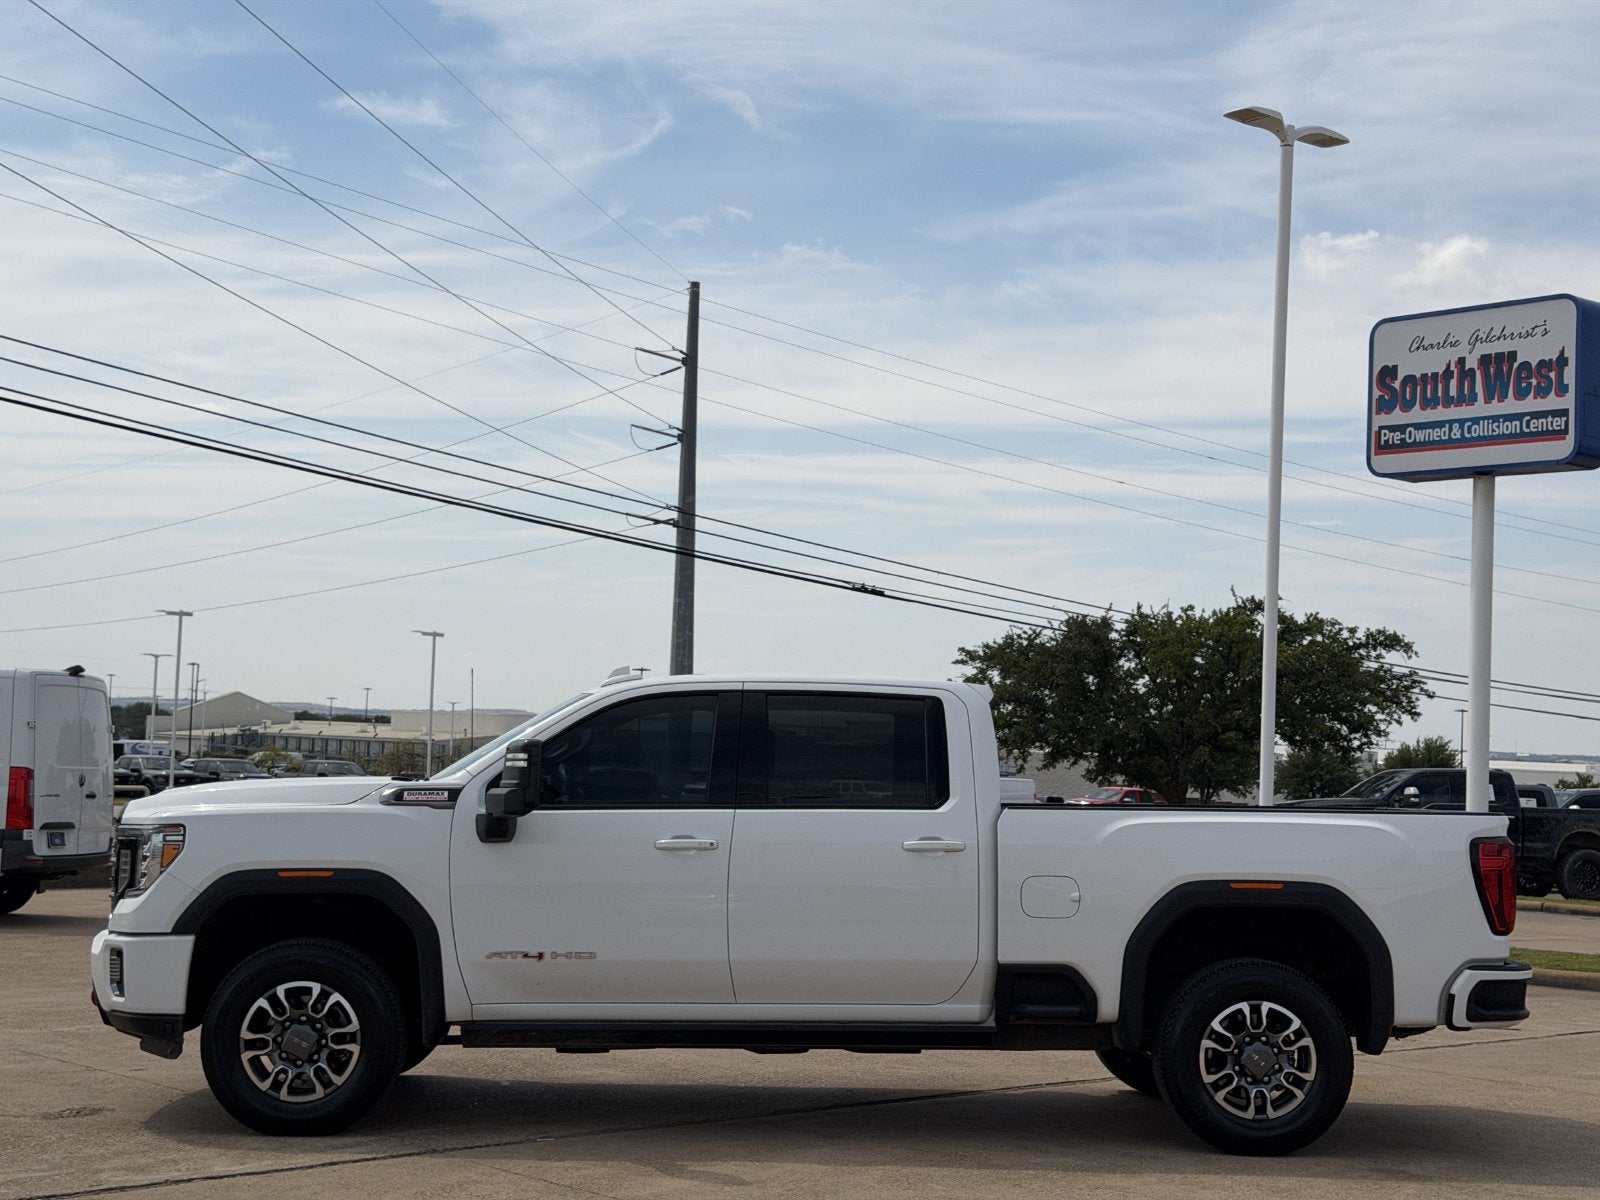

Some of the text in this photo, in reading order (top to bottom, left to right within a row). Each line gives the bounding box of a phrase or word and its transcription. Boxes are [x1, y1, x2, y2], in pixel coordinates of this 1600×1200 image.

[1409, 319, 1550, 354] Charlie Gilchrist's
[1380, 415, 1568, 445] Pre-Owned & Collision Center
